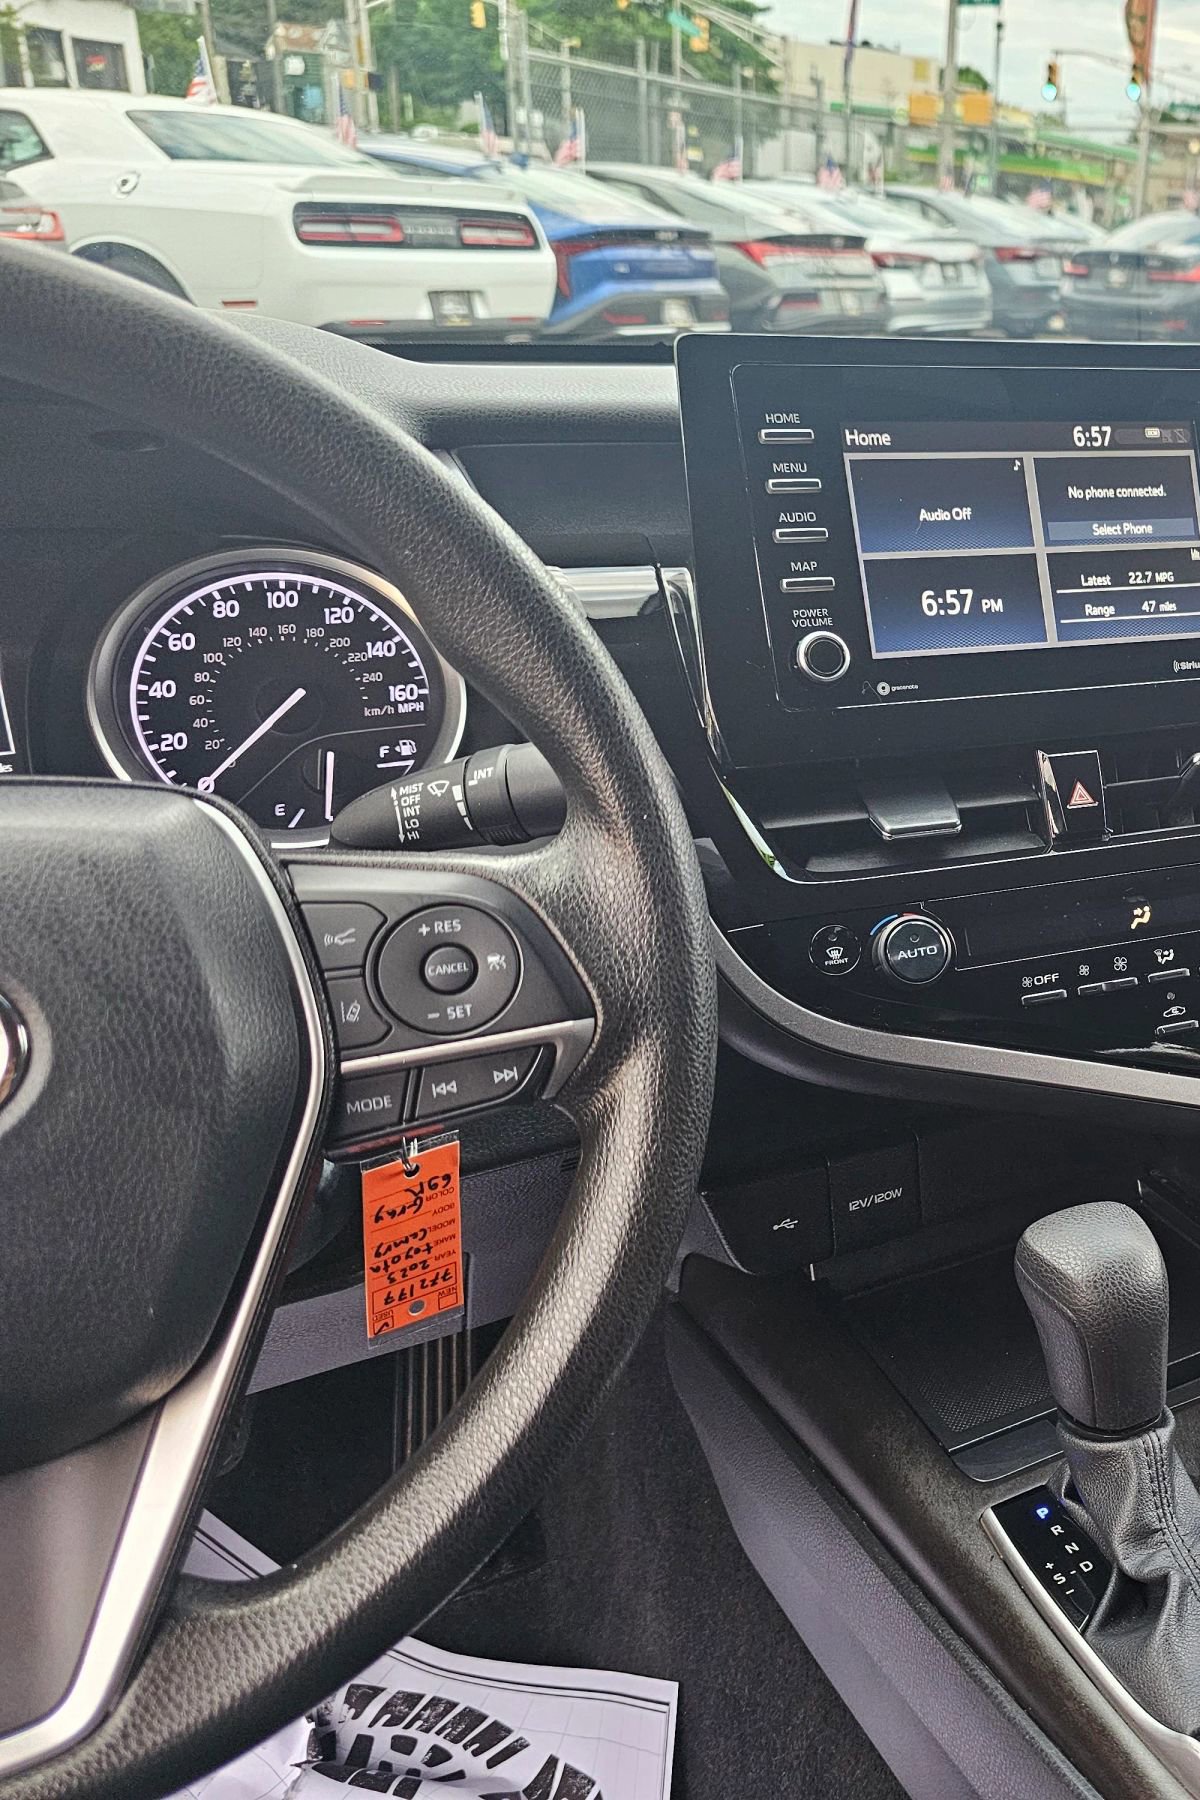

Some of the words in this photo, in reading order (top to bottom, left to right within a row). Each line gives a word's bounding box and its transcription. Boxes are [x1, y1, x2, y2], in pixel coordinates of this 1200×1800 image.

[765, 413, 800, 424] HOME
[845, 429, 891, 446] Home
[1073, 425, 1112, 447] 6:57
[772, 463, 807, 473] MENU
[1067, 486, 1083, 499] No
[1085, 486, 1115, 501] phone
[1116, 484, 1167, 498] connected.
[778, 512, 816, 523] AUDIO
[919, 508, 951, 521] Audio
[952, 507, 972, 521] Off
[1092, 523, 1122, 537] Select
[1123, 522, 1153, 535] Phone
[790, 561, 818, 572] MAP
[1080, 574, 1111, 587] Latest
[1128, 571, 1153, 584] 22.7
[1155, 571, 1174, 583] MPG
[266, 590, 299, 609] 100
[921, 588, 974, 617] 6:57
[981, 598, 1004, 613] PM
[212, 600, 240, 619] 80
[323, 607, 355, 624] 120
[793, 608, 829, 618] POWER
[1084, 603, 1115, 618] Range
[1141, 600, 1156, 613] 47
[1159, 601, 1177, 612] miles
[277, 624, 296, 634] 160
[791, 617, 834, 628] VOLUME
[248, 626, 267, 638] 140
[306, 627, 325, 638] 180
[168, 632, 196, 652] 60
[223, 636, 242, 647] 120
[329, 637, 350, 648] 200
[366, 639, 396, 658] 140
[203, 652, 223, 663] 100
[347, 652, 368, 662] 220
[194, 672, 210, 683] 80
[362, 672, 383, 683] 240
[148, 680, 177, 699] 40
[388, 683, 418, 702] 160
[189, 695, 205, 706] 60
[364, 704, 395, 717] km/h
[397, 701, 425, 713] MPH
[192, 718, 209, 729] 40
[160, 732, 188, 751] 20
[205, 740, 220, 750] 20
[379, 745, 390, 758] F
[473, 766, 494, 780] INT
[399, 782, 425, 796] MIST
[401, 793, 421, 807] OFF
[274, 803, 286, 817] E
[402, 805, 421, 818] INT
[404, 818, 420, 829] LO
[406, 830, 420, 841] HI
[434, 919, 462, 934] RES
[897, 945, 938, 960] AUTO
[824, 957, 849, 966] FRONT
[427, 961, 470, 976] CANCEL
[1034, 973, 1060, 985] OFF
[446, 1003, 473, 1020] SET
[346, 1095, 393, 1115] MODE
[425, 1186, 455, 1202] COLOR
[849, 1187, 903, 1212] 12V/120W
[432, 1202, 455, 1217] BODY
[427, 1218, 456, 1233] MODEL
[434, 1233, 457, 1246] MAKE
[434, 1249, 457, 1261] YEAR
[387, 1260, 430, 1284] 2023
[1036, 1506, 1049, 1519] P
[1050, 1524, 1065, 1536] R
[1064, 1542, 1080, 1554] N
[1079, 1560, 1094, 1573] D
[1052, 1572, 1067, 1585] S
